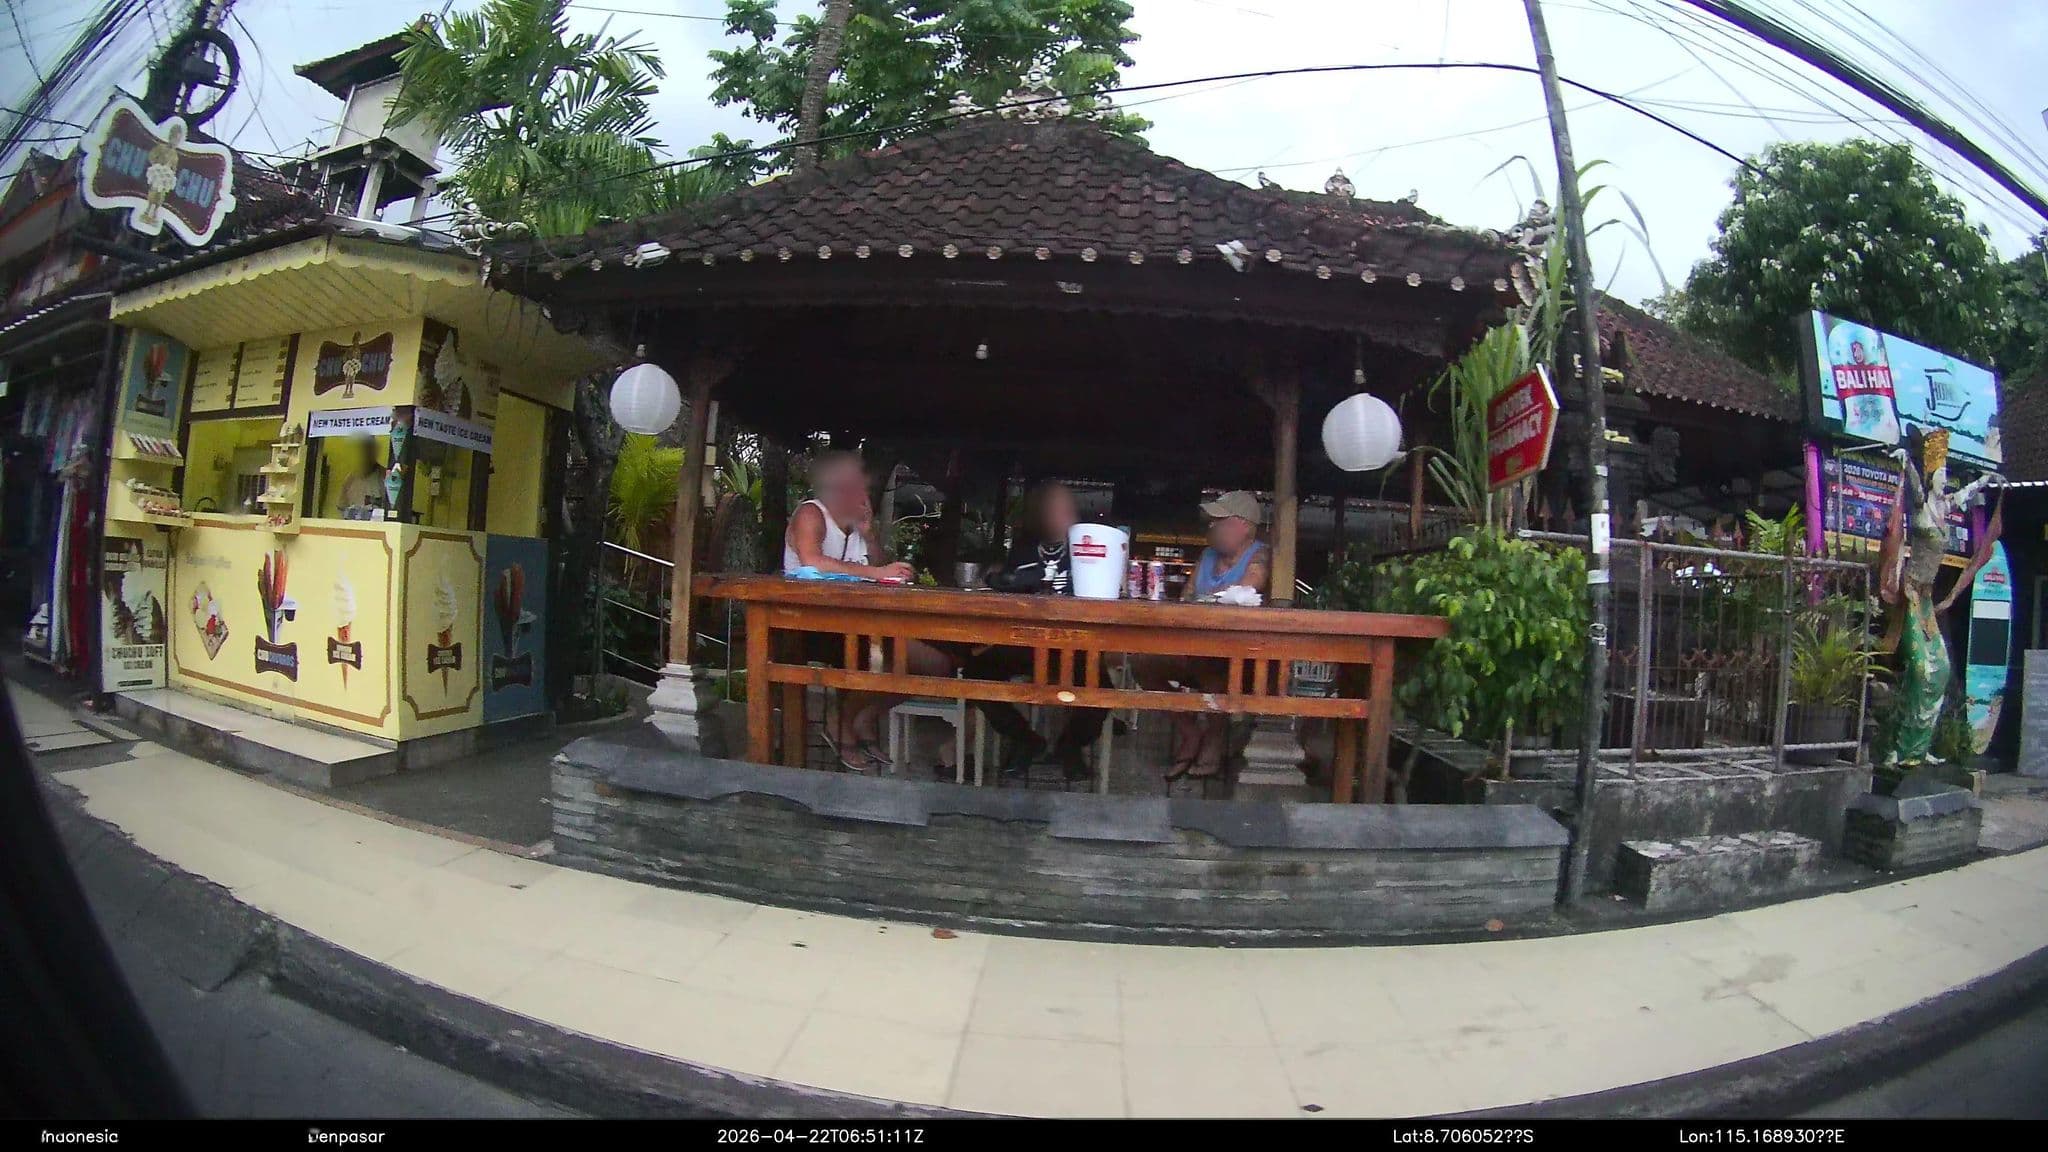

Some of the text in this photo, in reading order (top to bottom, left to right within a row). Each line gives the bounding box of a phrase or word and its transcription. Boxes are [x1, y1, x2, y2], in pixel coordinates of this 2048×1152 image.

[103, 137, 216, 209] CHU CHU
[1834, 369, 1892, 390] BALI HAI
[313, 415, 391, 429] NEW TASTE ICE CREAM
[418, 416, 434, 429] NEW
[434, 420, 456, 436] TASTE
[457, 426, 469, 439] ICE
[1861, 467, 1888, 482] TOYOTA
